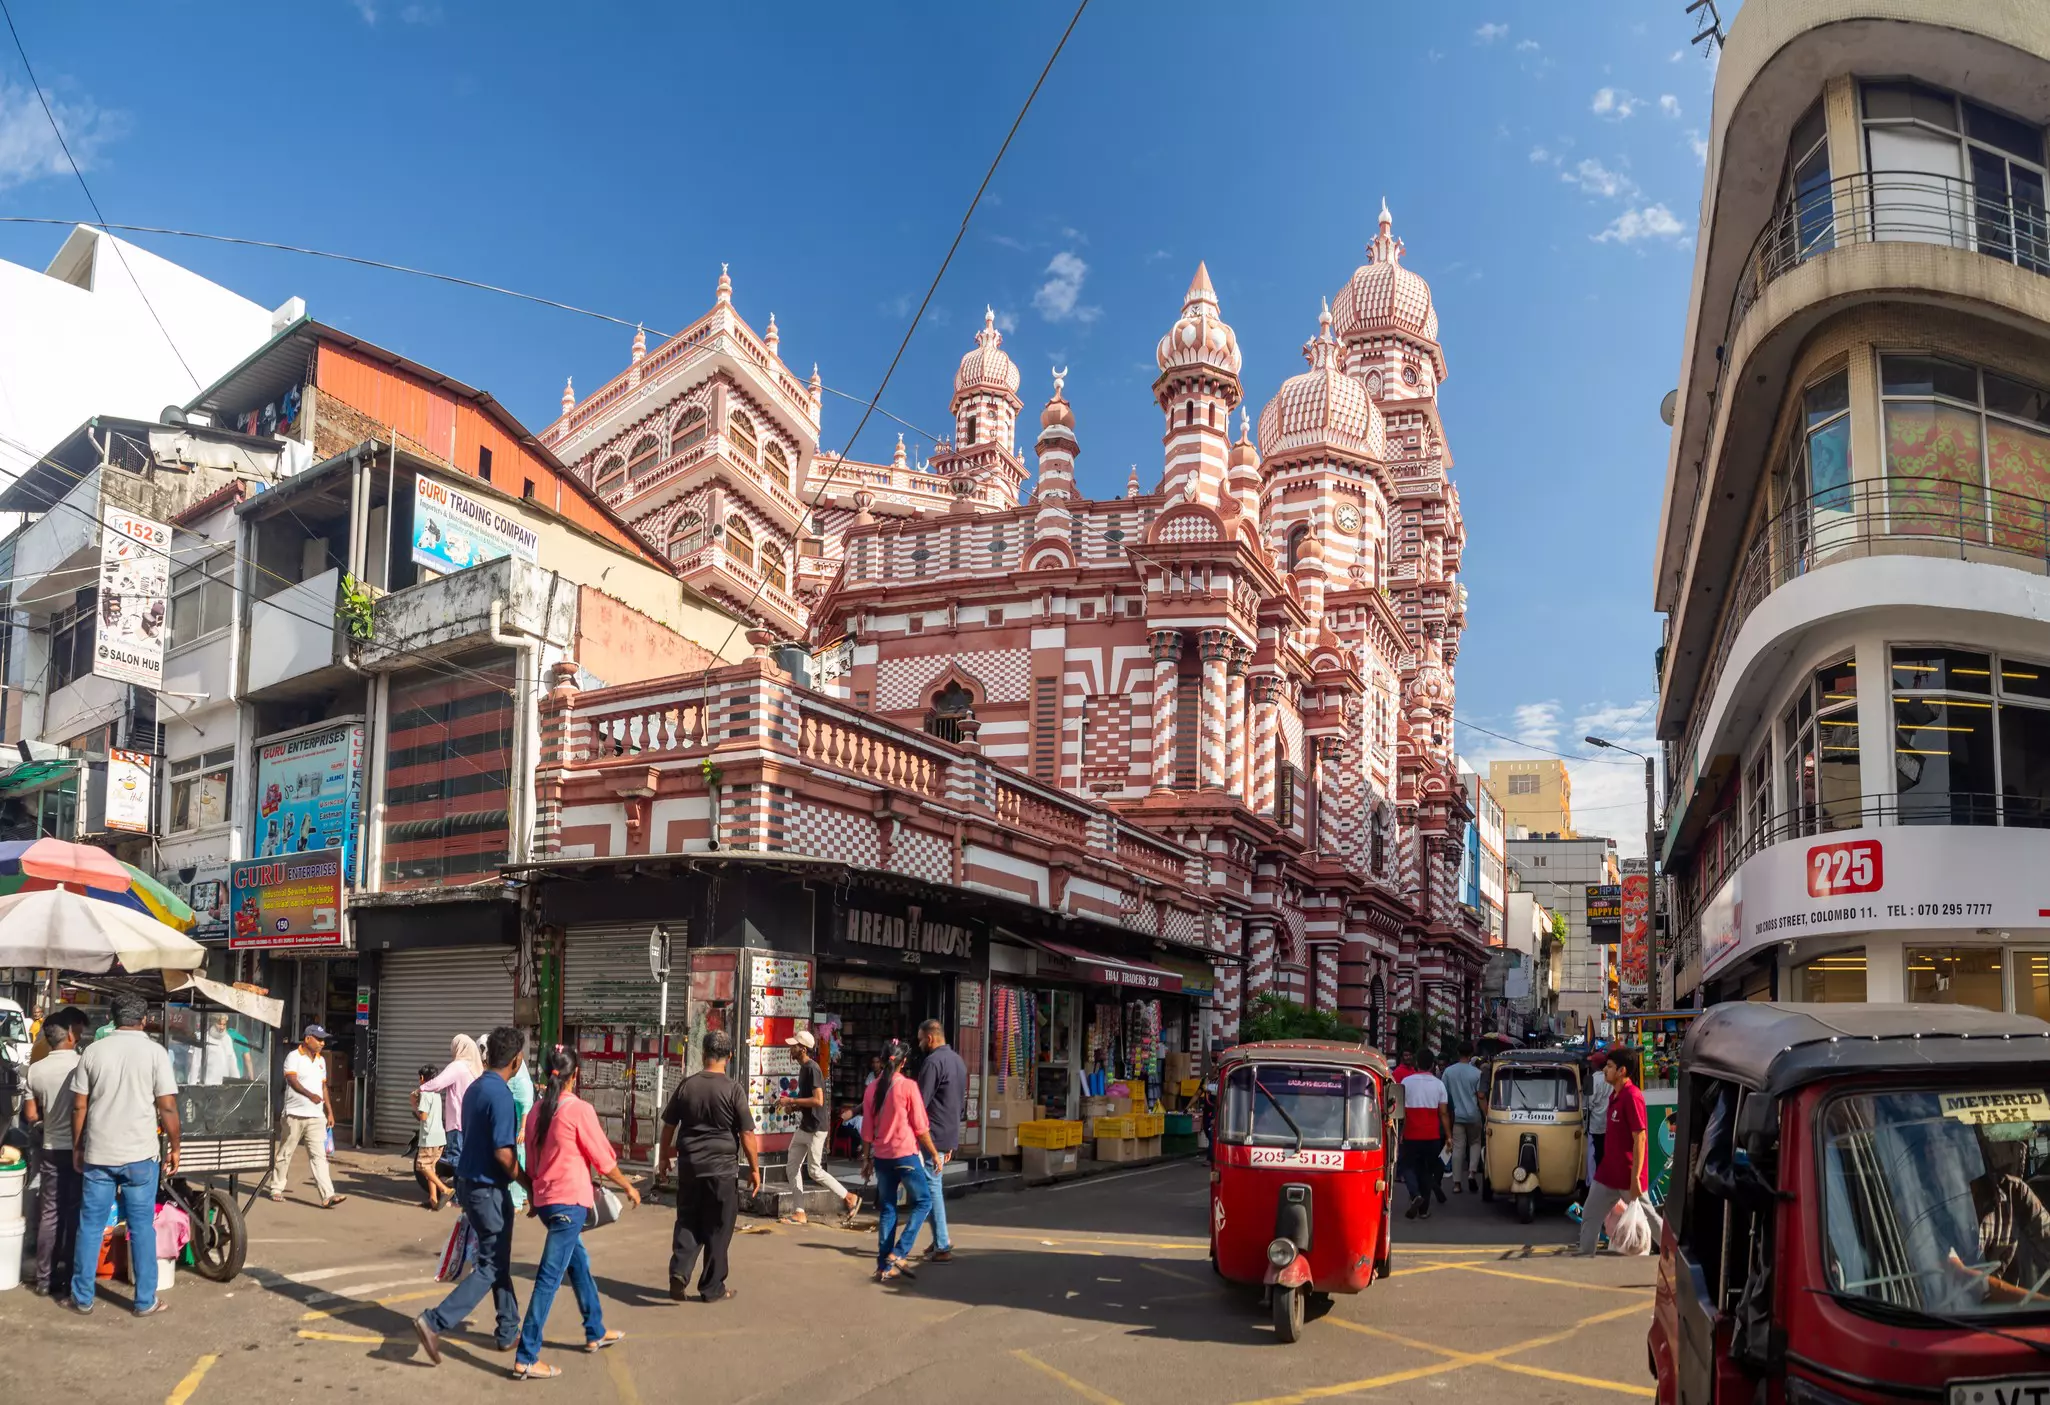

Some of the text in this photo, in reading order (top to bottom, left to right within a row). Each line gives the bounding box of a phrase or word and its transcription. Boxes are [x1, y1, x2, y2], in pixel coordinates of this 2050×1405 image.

[418, 479, 447, 505] GURU
[450, 493, 492, 526] TRADING
[494, 515, 537, 549] COMPANY
[124, 520, 153, 542] 152
[110, 649, 140, 666] SALON
[142, 657, 160, 672] HUB
[263, 745, 287, 760] GURU
[287, 730, 346, 754] ENTERPRISES
[116, 751, 145, 765] 152
[319, 810, 342, 820] Eastman
[234, 861, 337, 889] GURU ENTERPRISES
[1814, 847, 1874, 891] 225
[287, 887, 307, 897] Sewing
[307, 884, 335, 894] Machines
[1587, 907, 1613, 917] HAPPY
[1755, 923, 1763, 936] 2ND
[1762, 918, 1778, 934] CROSS
[1778, 913, 1808, 930] STREET,
[1810, 907, 1857, 924] COLOMBO
[1860, 906, 1878, 919] 11.
[1887, 904, 1907, 917] TEL
[1917, 904, 1939, 916] 070
[1942, 904, 1963, 916] 295
[1966, 903, 1993, 916] 7777
[276, 919, 288, 930] 150
[921, 920, 974, 959] HOUSE
[903, 951, 921, 964] 238
[1104, 969, 1159, 988] THAJ TRADERS 236
[1946, 1092, 2043, 1111] METERED
[1511, 1112, 1555, 1121] 97-6080
[1969, 1107, 2032, 1125] TAXI
[1252, 1151, 1342, 1167] 205-5132
